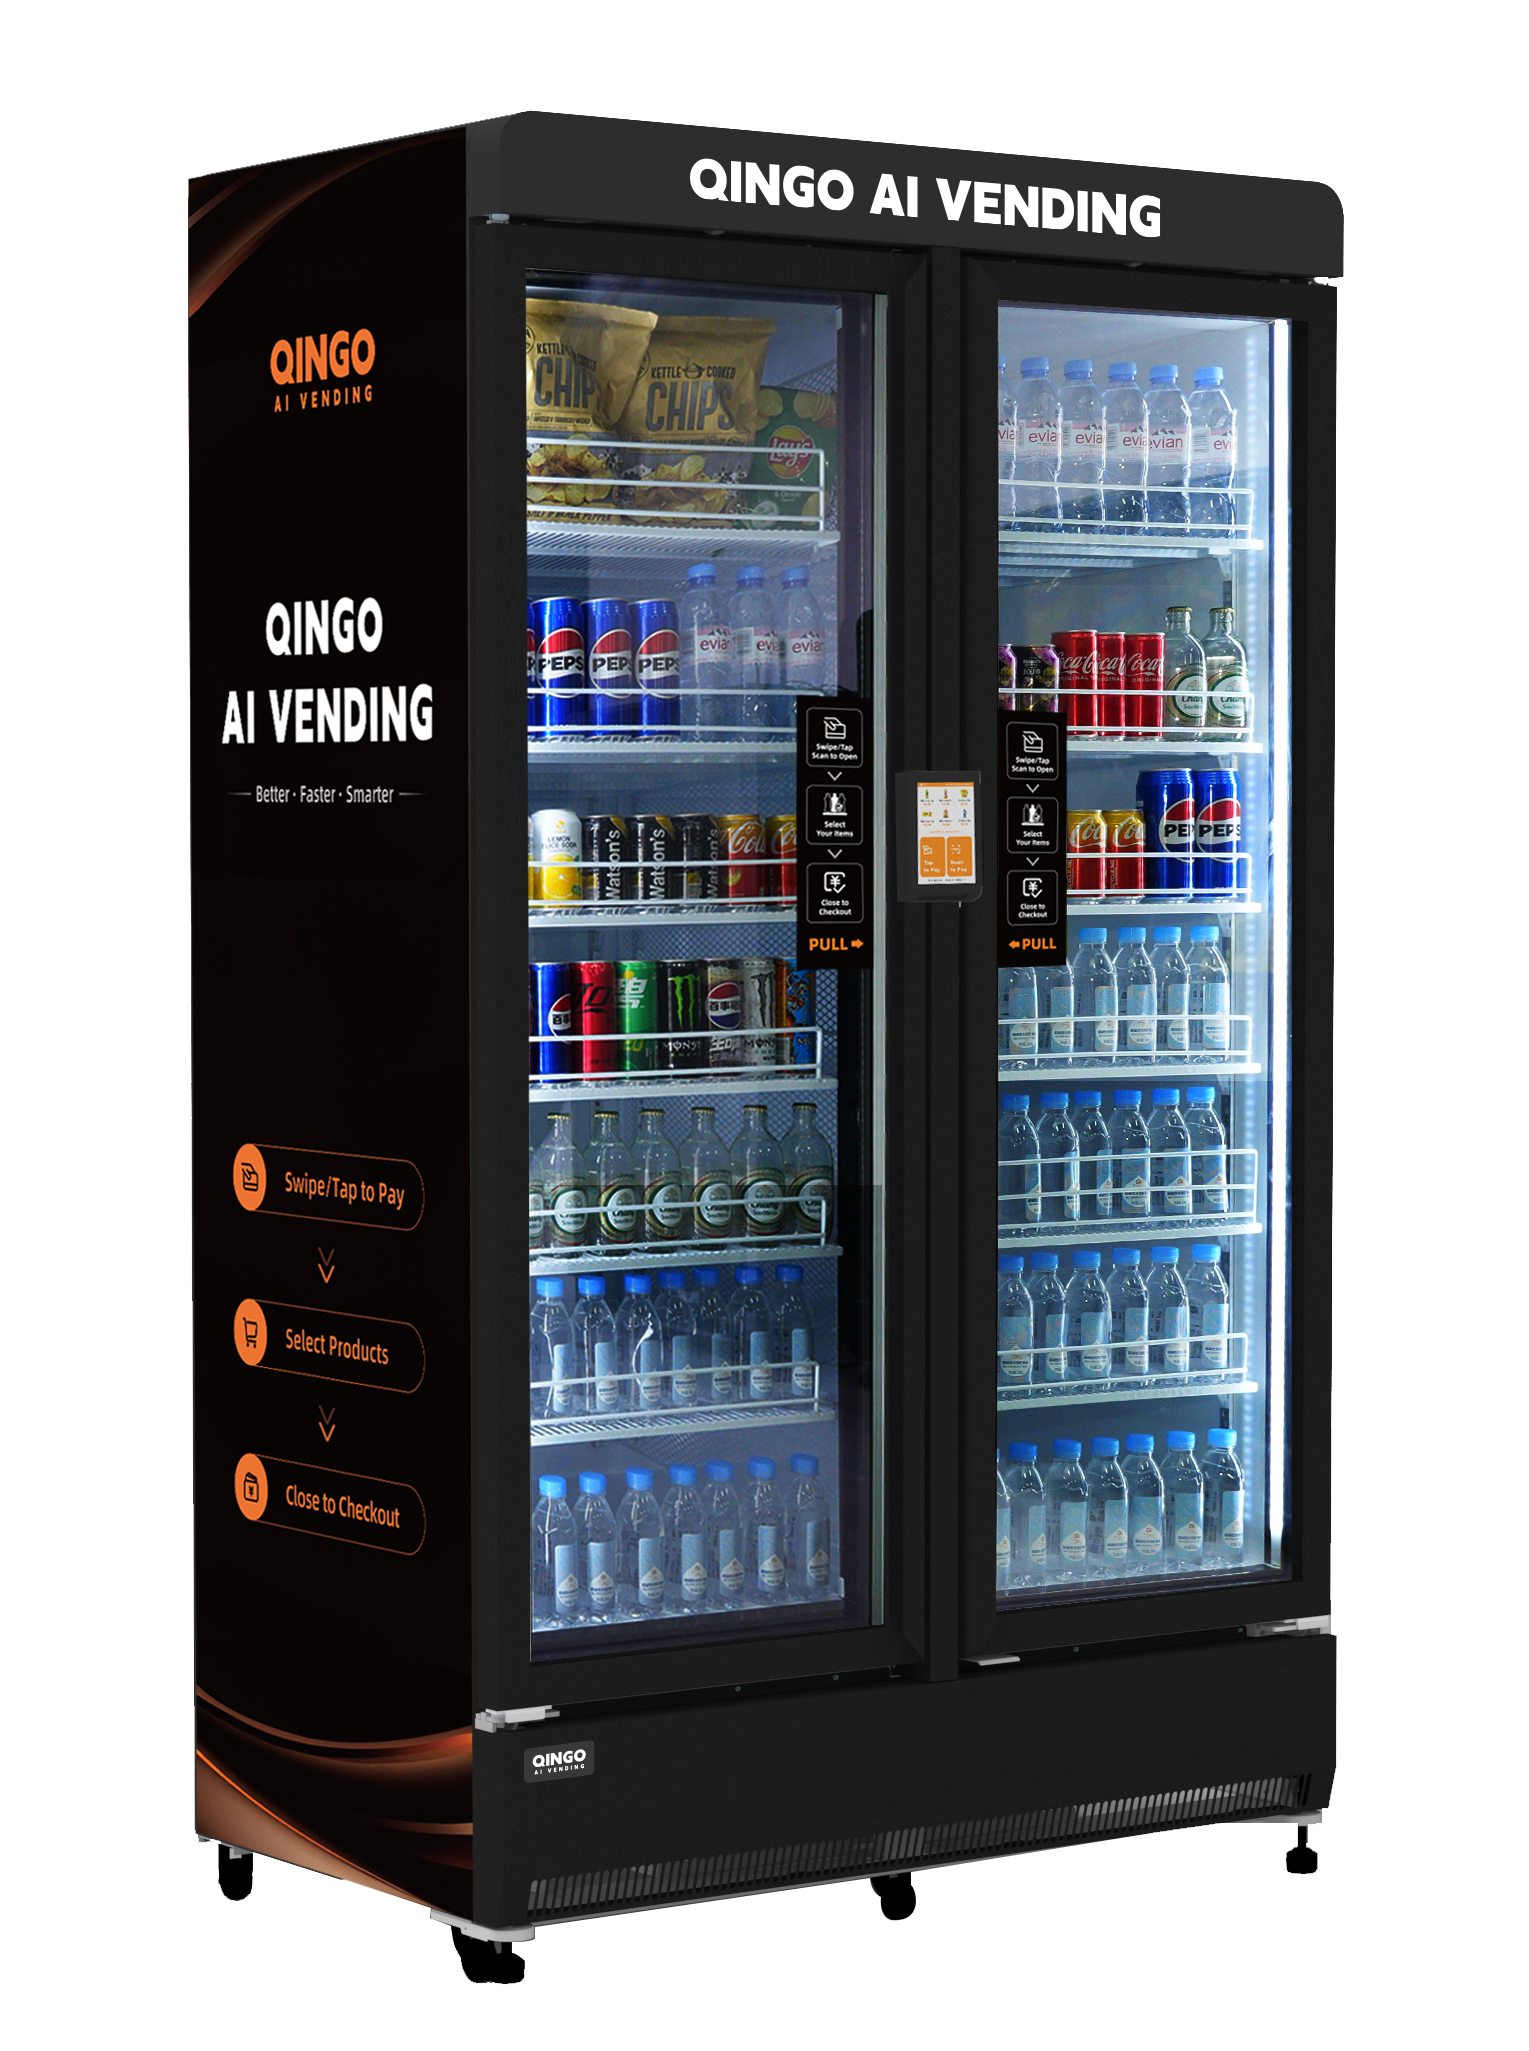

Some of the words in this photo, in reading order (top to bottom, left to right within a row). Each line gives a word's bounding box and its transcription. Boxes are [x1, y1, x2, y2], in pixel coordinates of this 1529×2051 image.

[689, 157, 854, 211] QINGO
[869, 173, 918, 217] AI
[936, 177, 1161, 238] VENDING
[270, 328, 376, 385] QINGO
[536, 342, 566, 355] KETTLE
[651, 365, 682, 379] KETTLE
[706, 365, 736, 380] COOKED
[274, 394, 289, 413] AI
[299, 384, 373, 410] VENDING
[645, 380, 735, 432] CHIPS
[769, 437, 811, 467] Lay's
[265, 596, 383, 656] QINGO
[222, 690, 255, 744] AI
[268, 683, 433, 743] VENDING
[811, 752, 829, 760] Scan
[830, 752, 838, 760] to
[838, 752, 858, 761] Open
[816, 742, 854, 752] Swipe/Tap
[1011, 765, 1028, 773] Scan
[1028, 765, 1036, 773] to
[1036, 765, 1054, 774] Open
[1015, 756, 1050, 765] Swipe/Tap
[256, 785, 290, 803] Better
[300, 785, 336, 803] Faster
[346, 785, 394, 804] Smarter
[824, 820, 846, 828] Select
[834, 830, 854, 838] Items
[606, 829, 620, 900] Watson's
[649, 828, 665, 900] Watson's
[818, 908, 852, 916] Checkout
[1018, 911, 1048, 919] Checkout
[809, 937, 849, 951] PULL
[1022, 937, 1057, 950] PULL
[285, 1171, 357, 1206] Swipe/Tap
[360, 1181, 375, 1202] to
[379, 1182, 405, 1211] Pay
[286, 1328, 326, 1355] Select
[329, 1335, 389, 1365] Products
[286, 1484, 320, 1511] Close
[322, 1493, 336, 1514] to
[339, 1495, 400, 1529] Checkout
[532, 1748, 587, 1768] QINGO
[547, 1763, 585, 1774] VENDING
